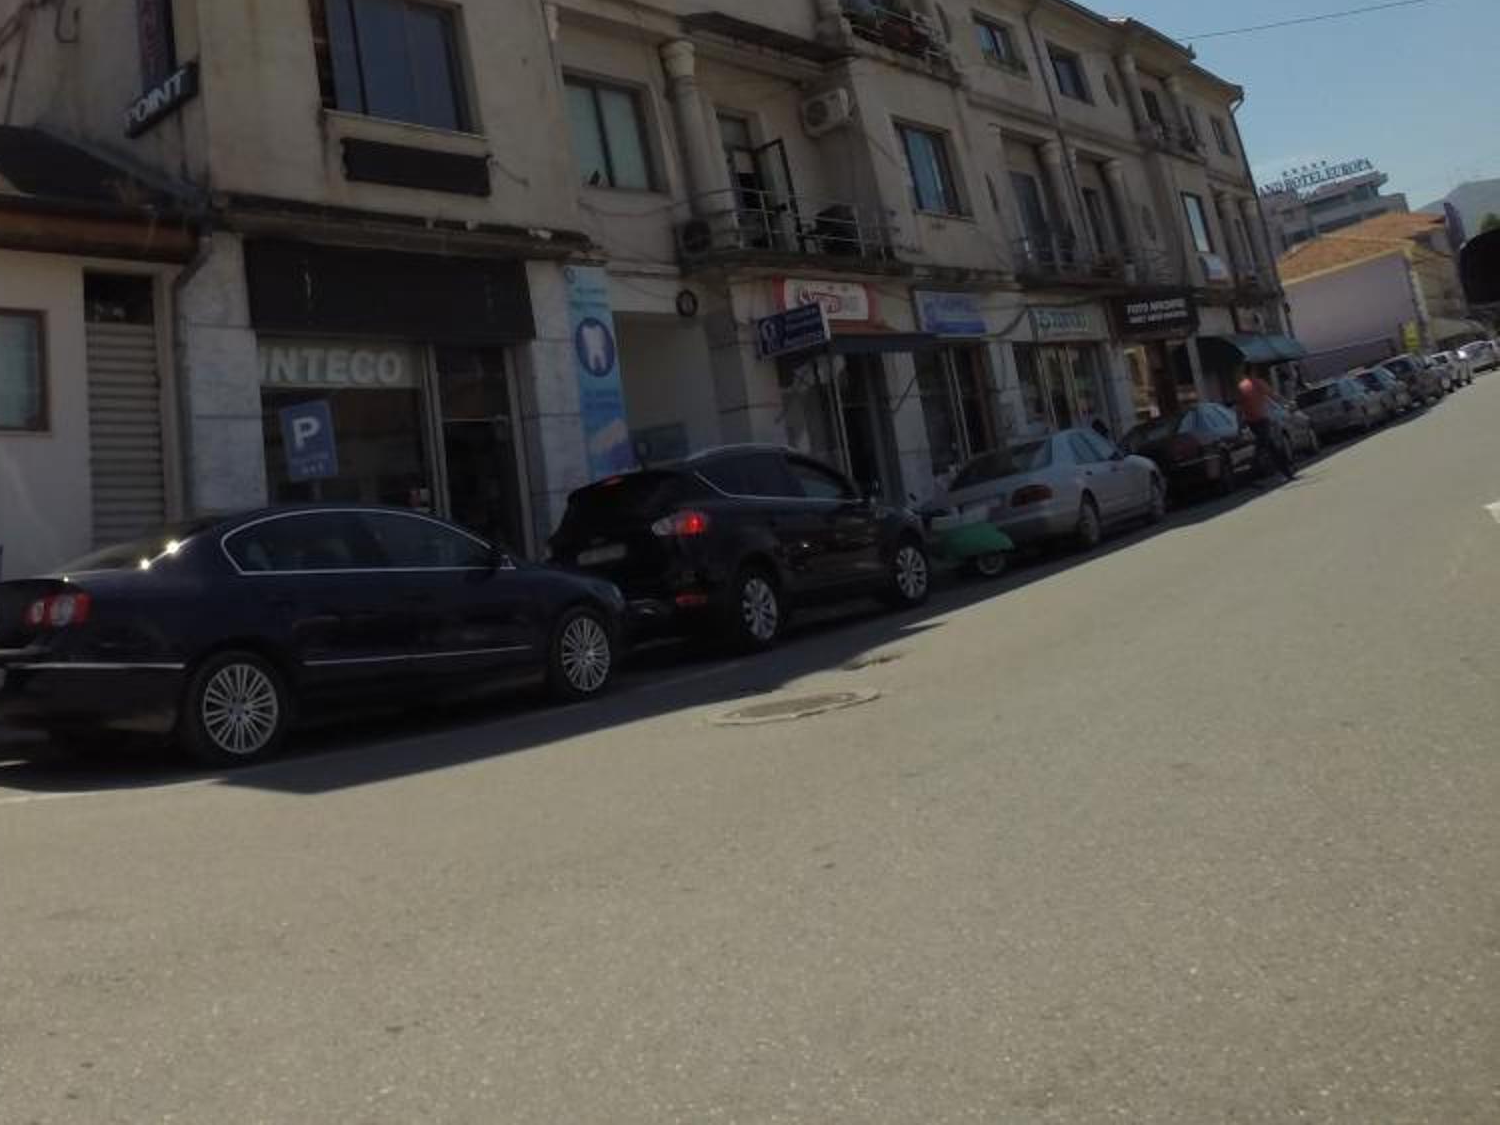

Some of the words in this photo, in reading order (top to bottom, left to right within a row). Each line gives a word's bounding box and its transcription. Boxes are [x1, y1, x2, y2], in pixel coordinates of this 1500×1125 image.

[1283, 171, 1325, 192] HOTEL
[1324, 157, 1373, 180] EUROPA
[293, 416, 320, 449] P
